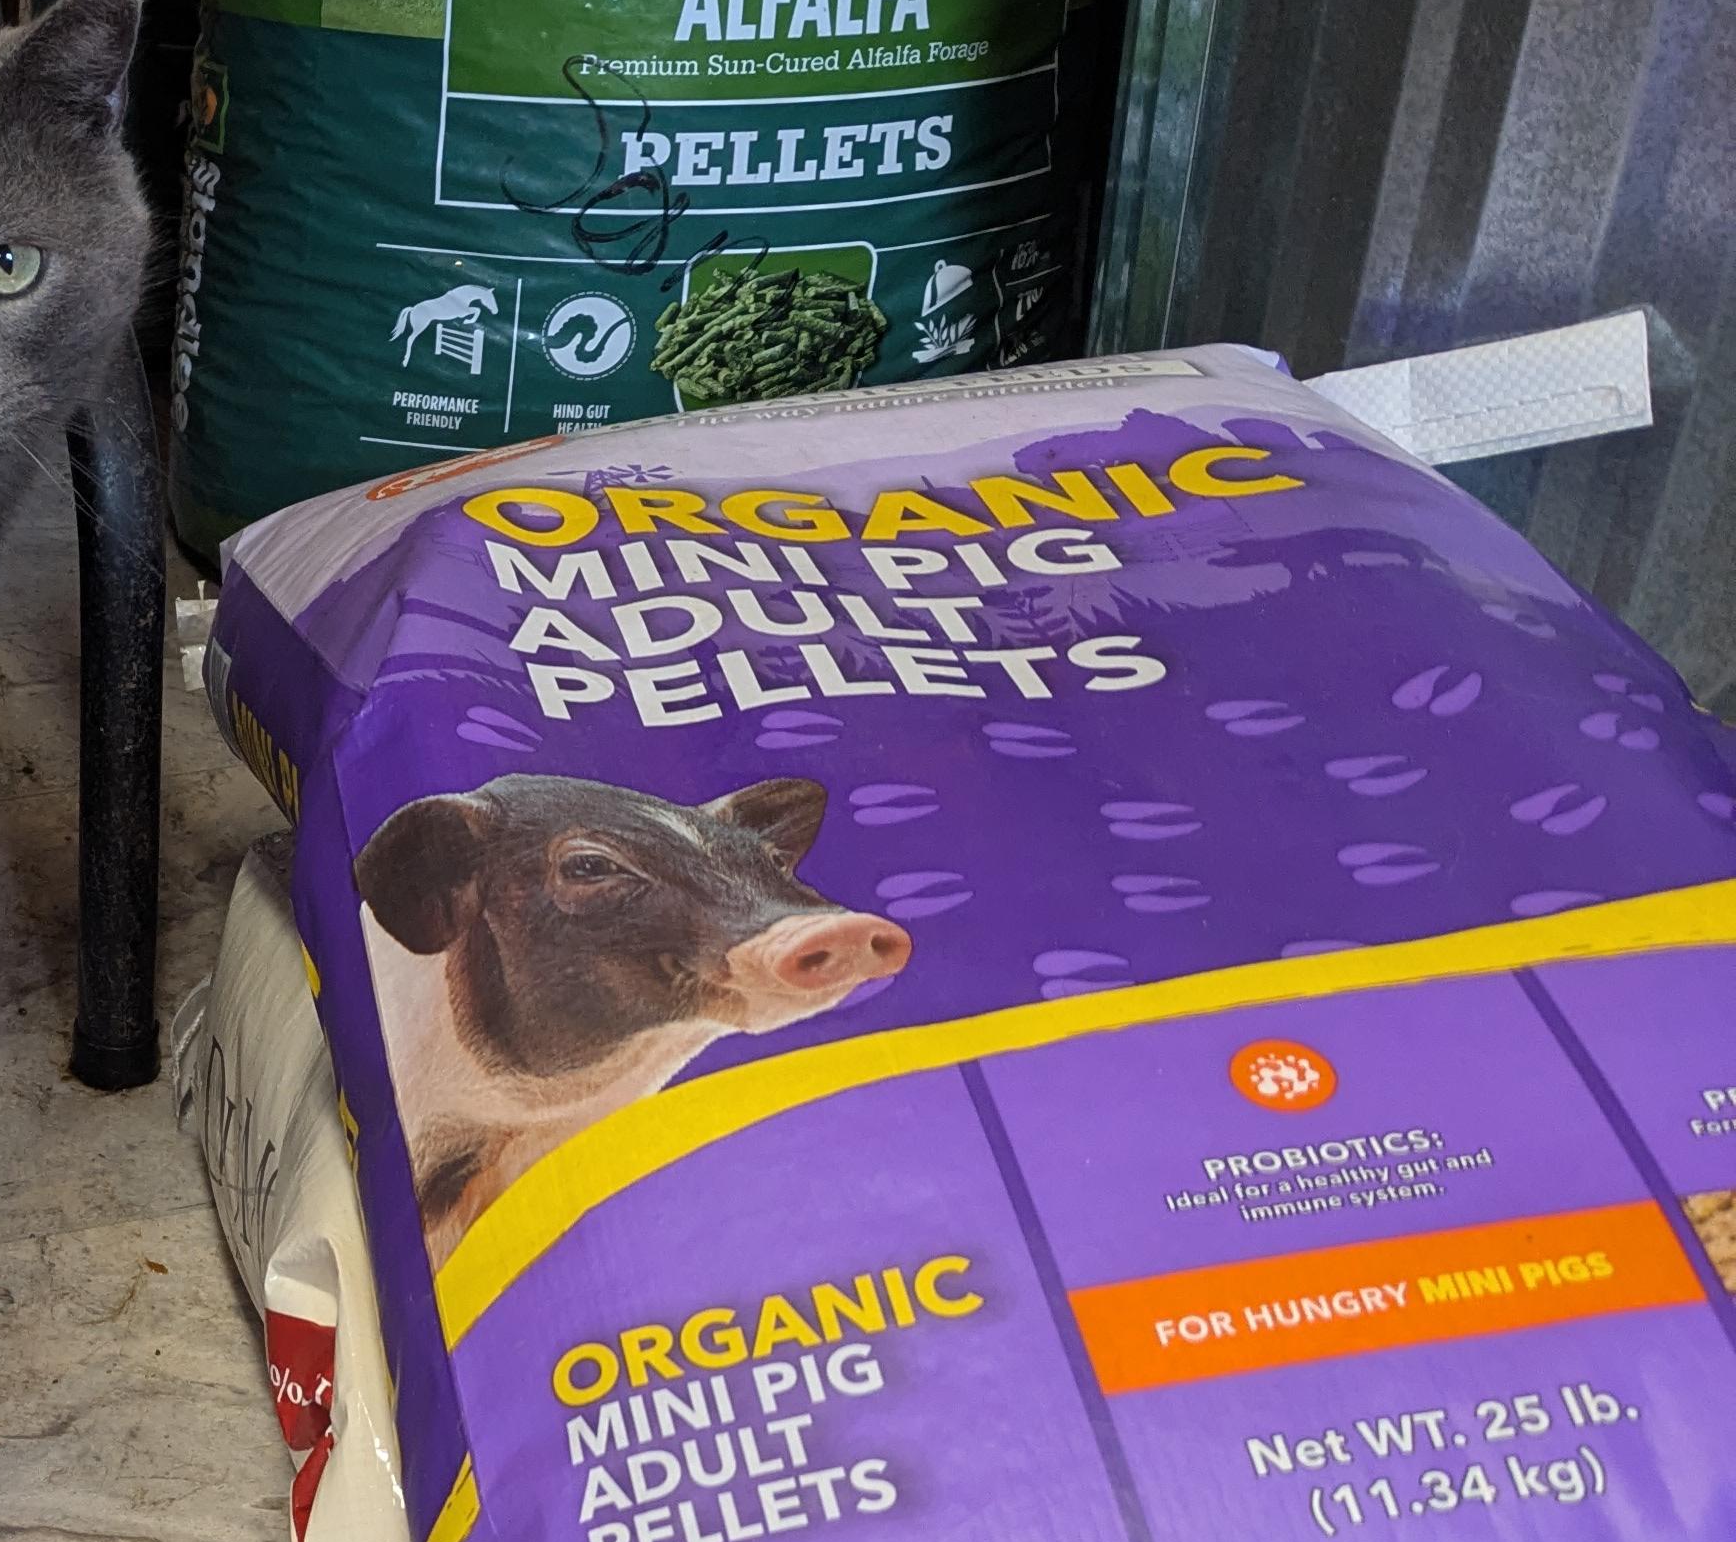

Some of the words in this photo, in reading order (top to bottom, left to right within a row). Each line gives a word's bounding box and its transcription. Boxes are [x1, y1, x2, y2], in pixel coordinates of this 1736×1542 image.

[579, 53, 699, 77] Premium
[707, 50, 840, 77] Sun-Cured
[847, 45, 921, 70] Alfalfa
[928, 38, 989, 64] Forage
[617, 114, 954, 186] PELLETS
[392, 391, 480, 415] PERFORMANCE
[406, 411, 463, 430] FRIENDLY
[553, 404, 583, 419] HIND
[586, 404, 612, 419] GUT
[462, 447, 1306, 547] ORGANIC
[483, 539, 830, 601] MINI
[861, 528, 1122, 591] PIG
[508, 590, 985, 661] ADULT
[527, 636, 1167, 727] PELLETS
[1166, 1186, 1230, 1213] Ideal
[1234, 1182, 1270, 1201] for
[1277, 1179, 1293, 1195] a
[1296, 1164, 1391, 1191] healthy
[1397, 1157, 1441, 1179] gut
[1446, 1148, 1493, 1171] and
[1203, 1128, 1445, 1182] PROBIOTICS:
[1240, 1194, 1343, 1222] immune
[1349, 1180, 1447, 1208] system.
[552, 1255, 984, 1407] ORGANIC
[1153, 1308, 1237, 1347] FOR
[1243, 1281, 1408, 1333] HUNGRY
[1416, 1264, 1515, 1305] MINI
[1518, 1250, 1615, 1290] PIGS
[566, 1375, 736, 1467] MINI
[752, 1342, 885, 1415] PIG
[1245, 1426, 1352, 1479] Net
[1354, 1409, 1468, 1459] WT.
[1475, 1393, 1552, 1442] 25
[1559, 1381, 1641, 1428] lb.
[579, 1413, 814, 1524] ADULT
[1309, 1462, 1499, 1537] (11.34
[1504, 1443, 1608, 1503] kg)
